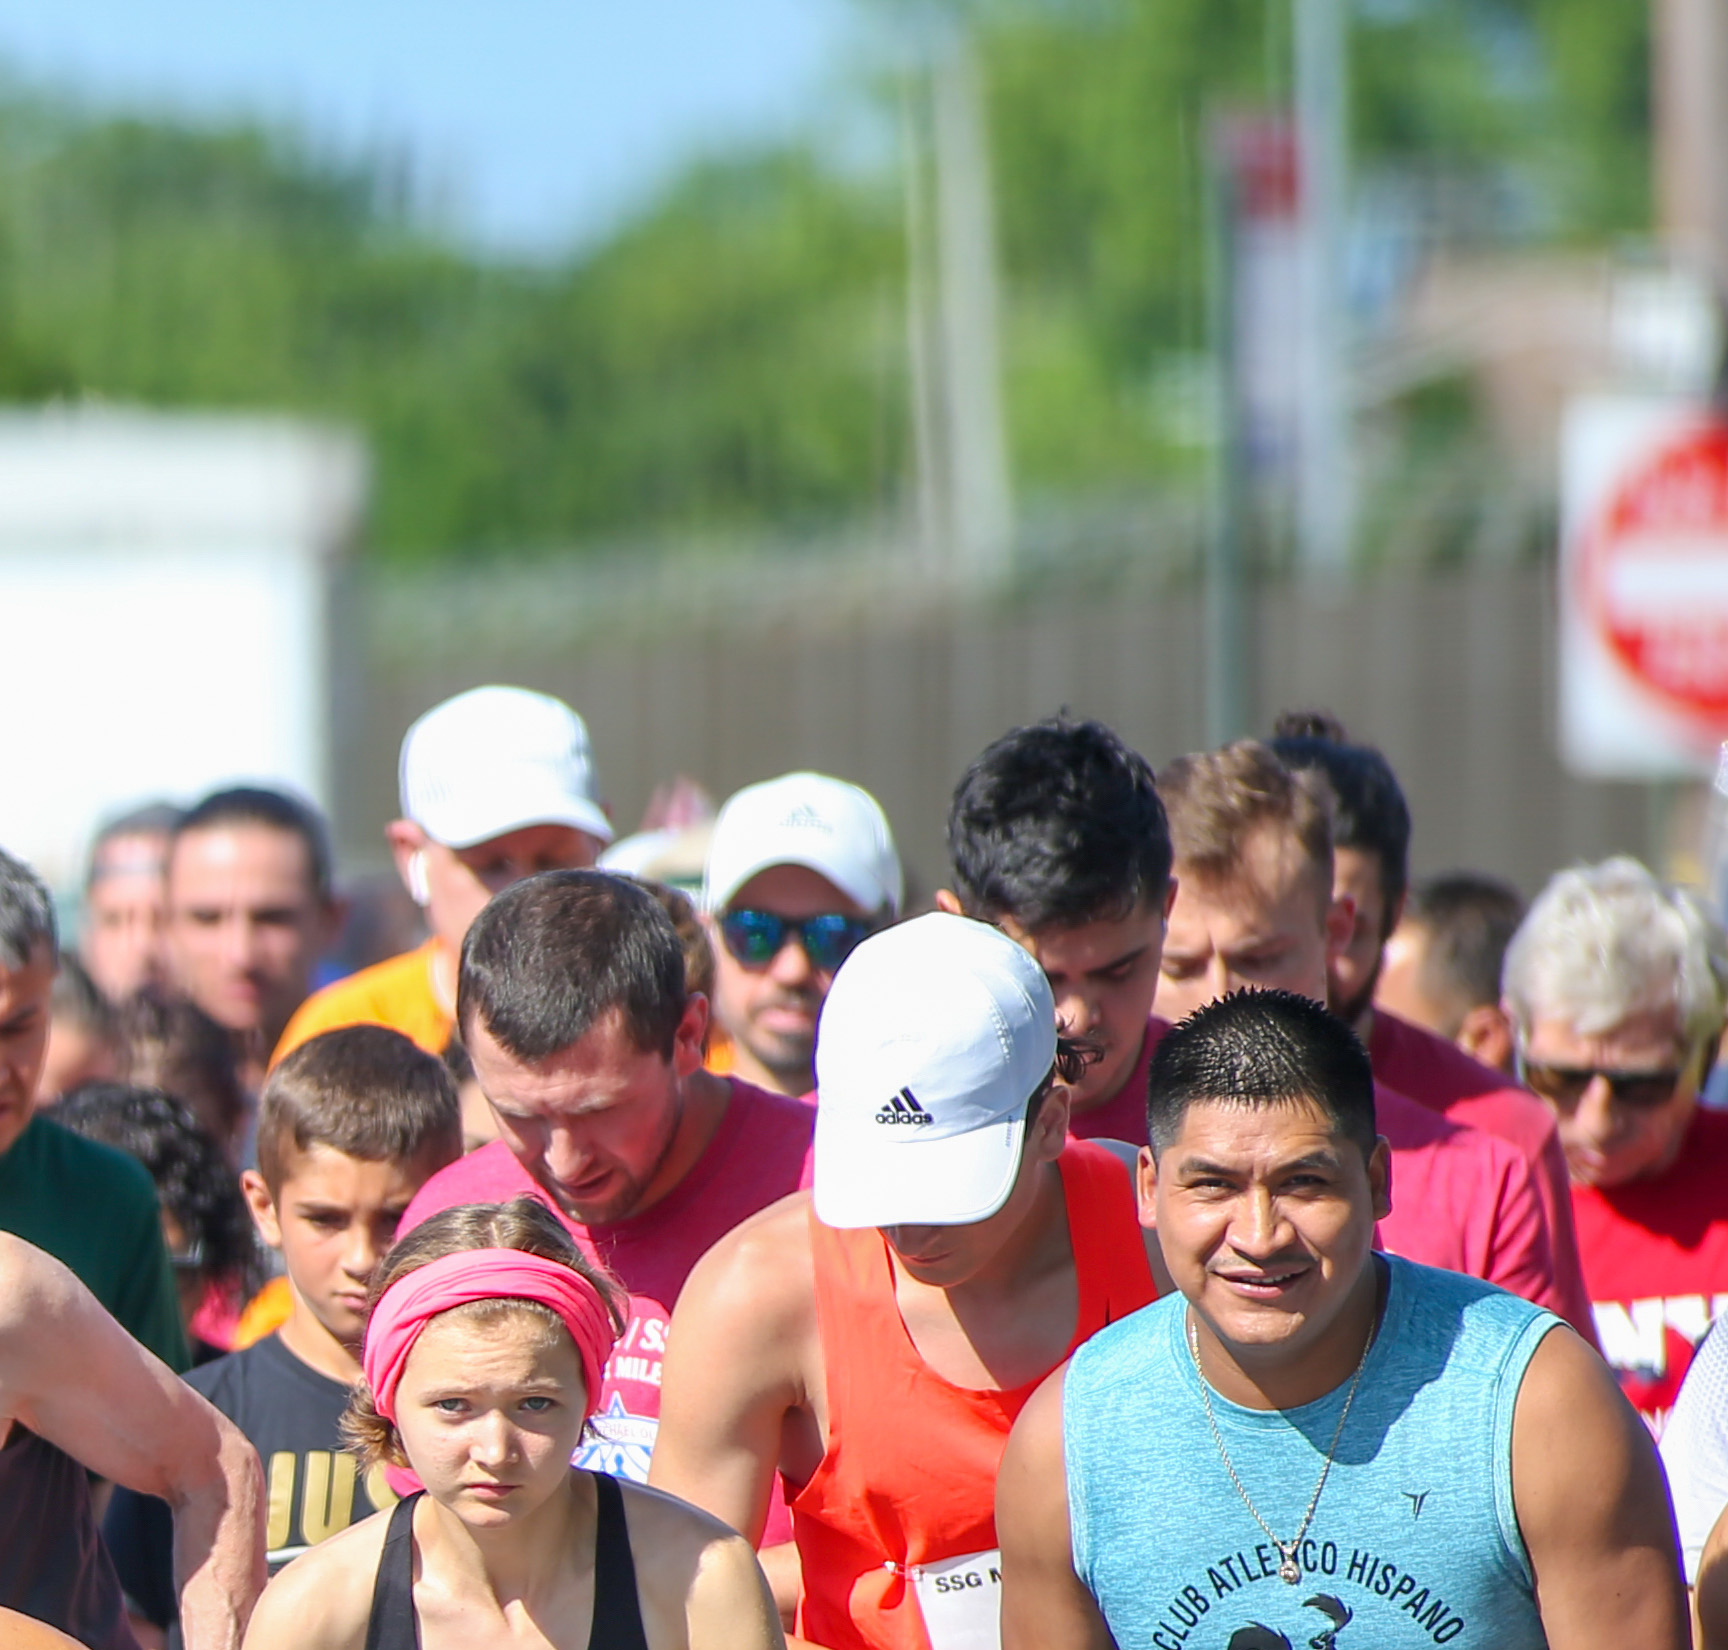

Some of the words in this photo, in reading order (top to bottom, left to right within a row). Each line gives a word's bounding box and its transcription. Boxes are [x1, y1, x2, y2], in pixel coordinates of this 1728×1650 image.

[875, 1111, 935, 1126] adidas
[934, 1571, 984, 1594] SSG
[1346, 1549, 1465, 1644] HISPANO
